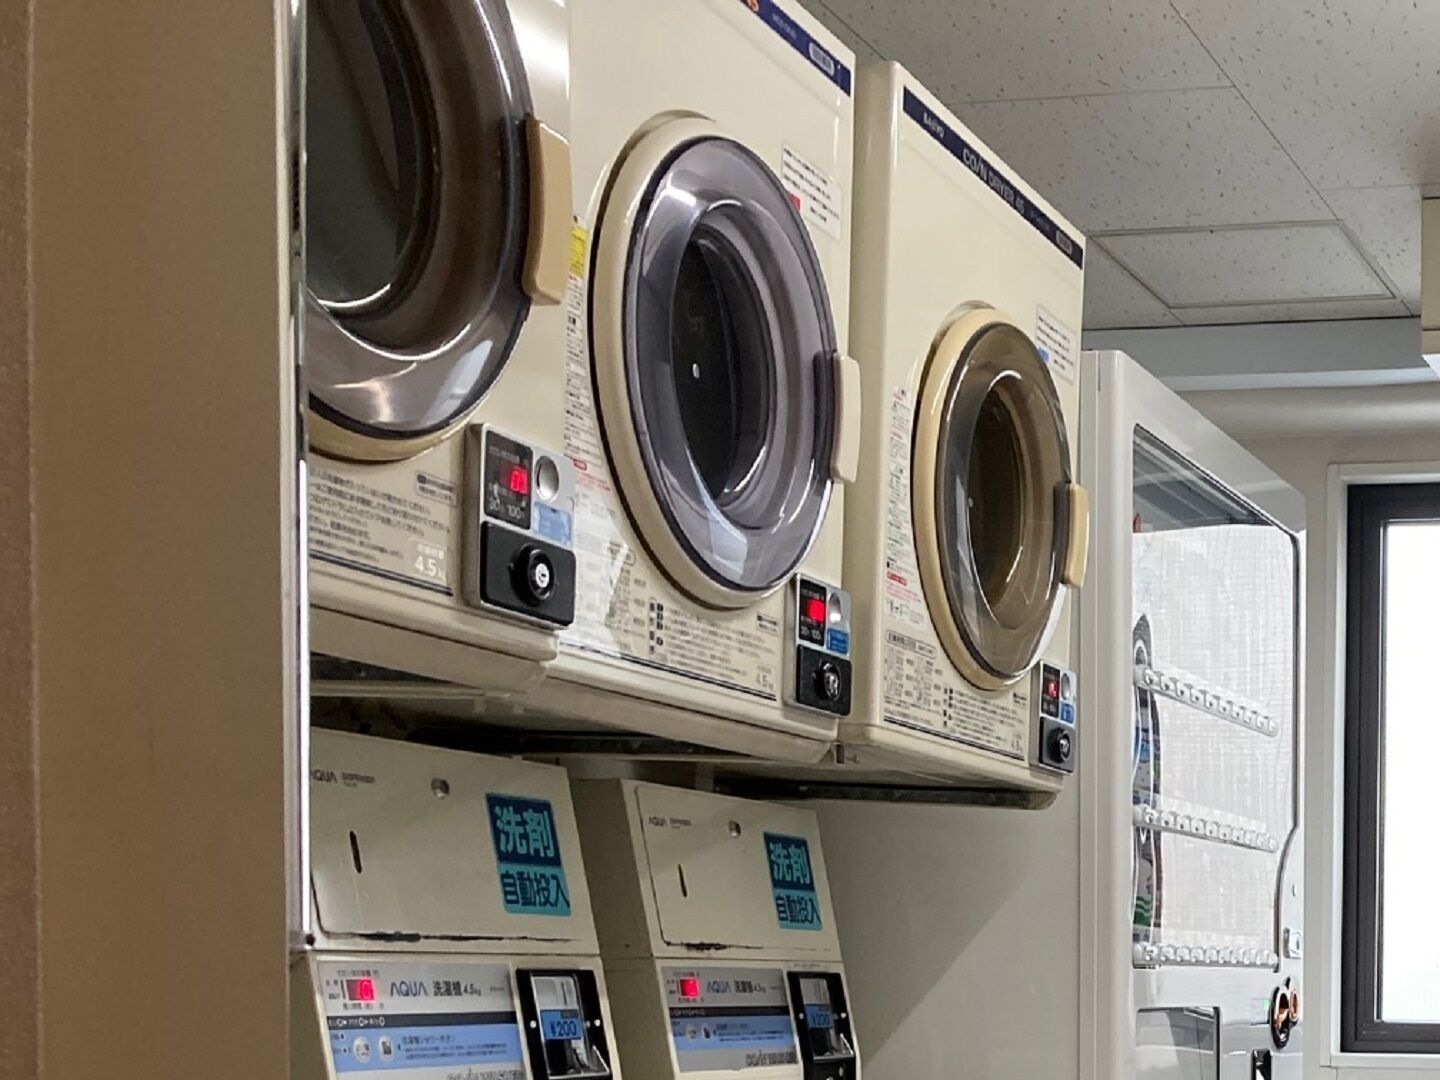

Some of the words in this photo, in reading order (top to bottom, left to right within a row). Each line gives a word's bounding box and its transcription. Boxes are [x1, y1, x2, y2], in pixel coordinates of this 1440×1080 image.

[310, 769, 338, 783] QUA
[494, 806, 556, 858] 洗剤
[769, 842, 811, 885] 洗剤
[500, 870, 571, 908] 自動投入
[775, 894, 822, 925] 自動投入
[390, 980, 428, 997] AQUA
[549, 1020, 577, 1037] ¥200
